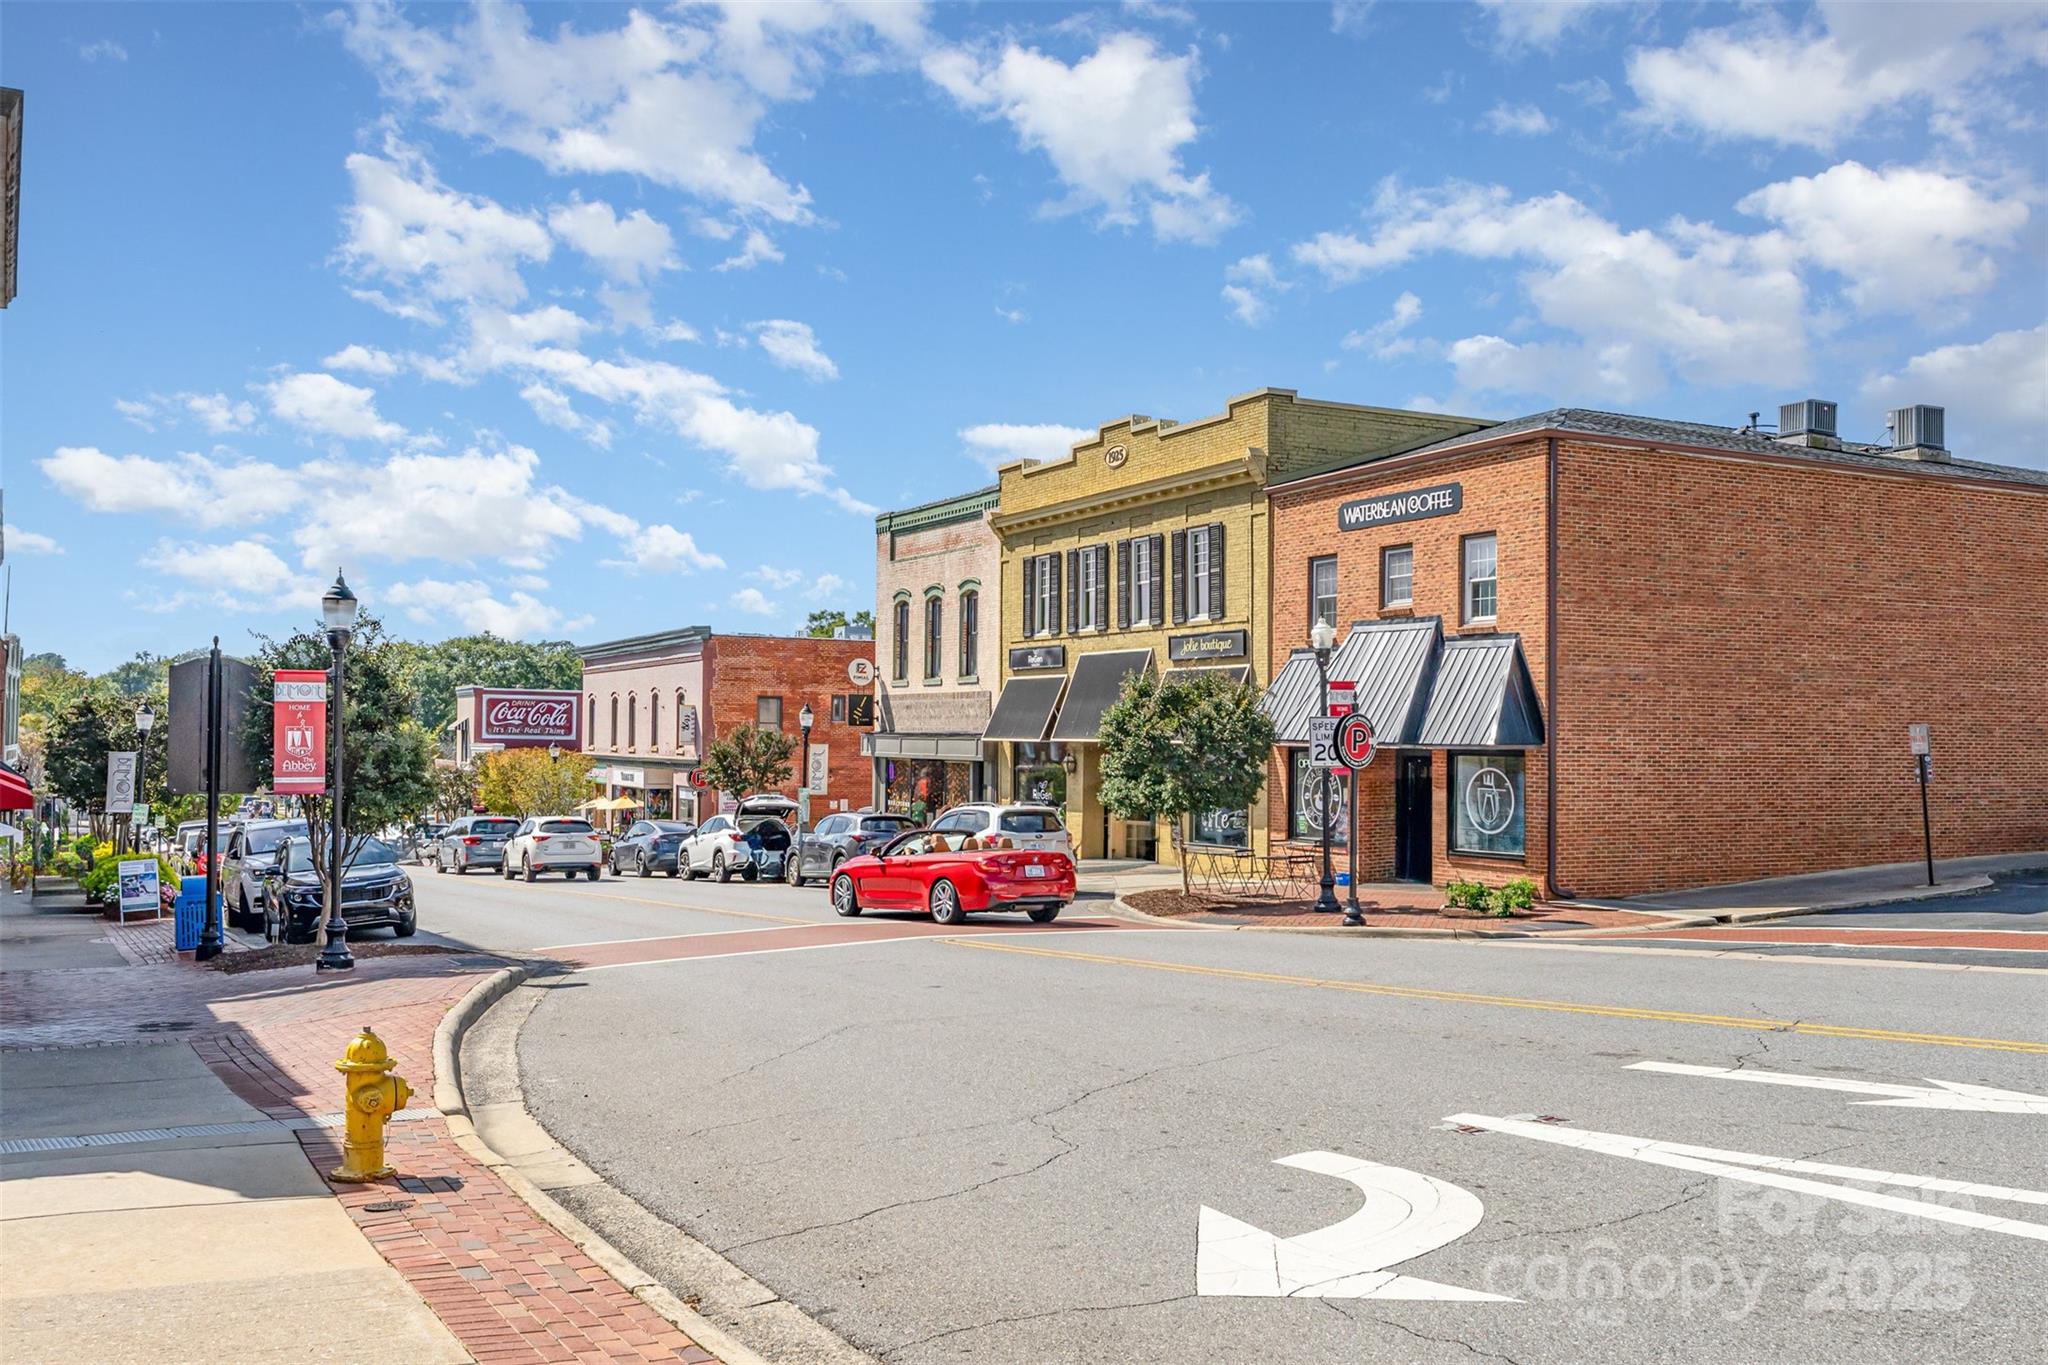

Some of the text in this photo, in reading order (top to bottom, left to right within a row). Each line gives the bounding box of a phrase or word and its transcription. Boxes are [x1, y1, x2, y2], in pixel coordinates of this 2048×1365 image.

[1108, 449, 1124, 463] 1925
[1343, 489, 1453, 525] WATERBEAN COFFEE
[1180, 638, 1233, 656] jolie boutique
[489, 701, 571, 726] Coca-Cola
[1312, 721, 1335, 732] SPEE
[1315, 733, 1334, 741] LIMI
[1351, 728, 1367, 753] P
